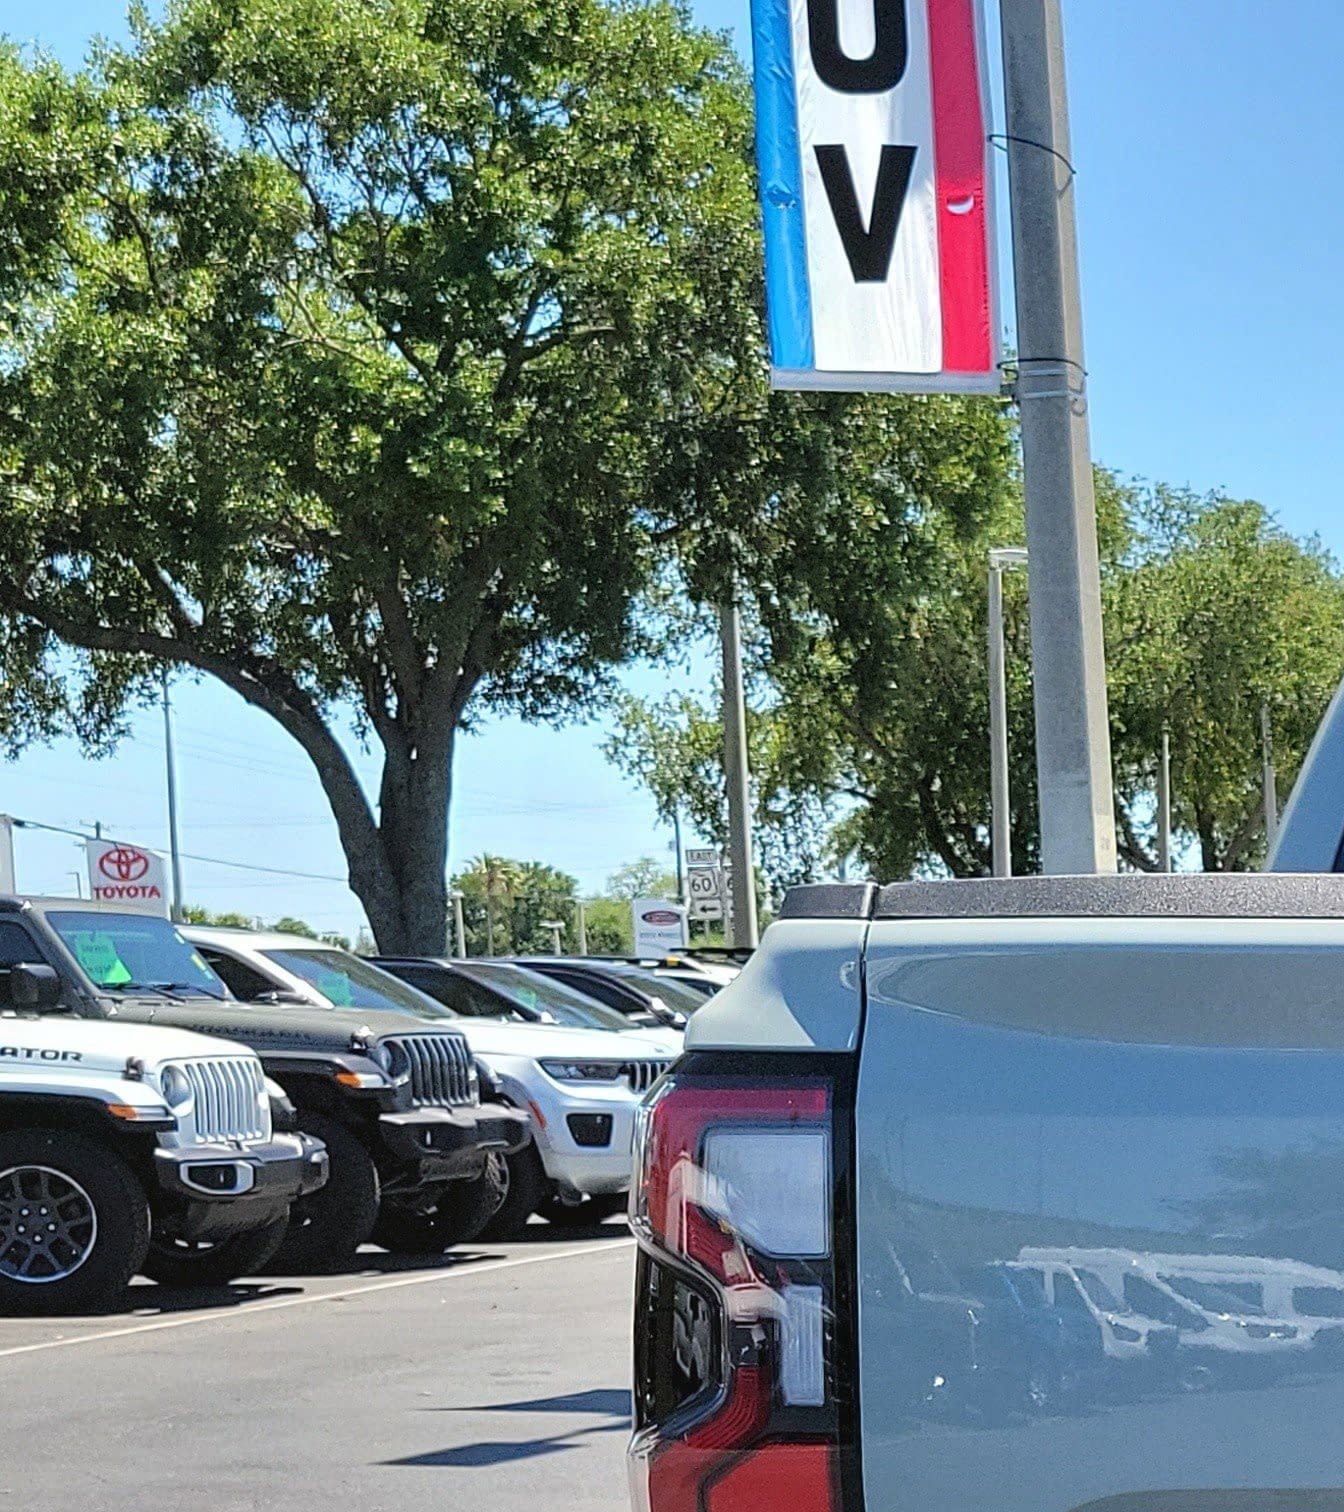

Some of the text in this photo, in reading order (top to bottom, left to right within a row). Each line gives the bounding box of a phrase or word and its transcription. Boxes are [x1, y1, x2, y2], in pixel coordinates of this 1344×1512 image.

[94, 885, 161, 900] TOYOTA
[691, 878, 712, 892] 60
[0, 1046, 83, 1062] ATOR
